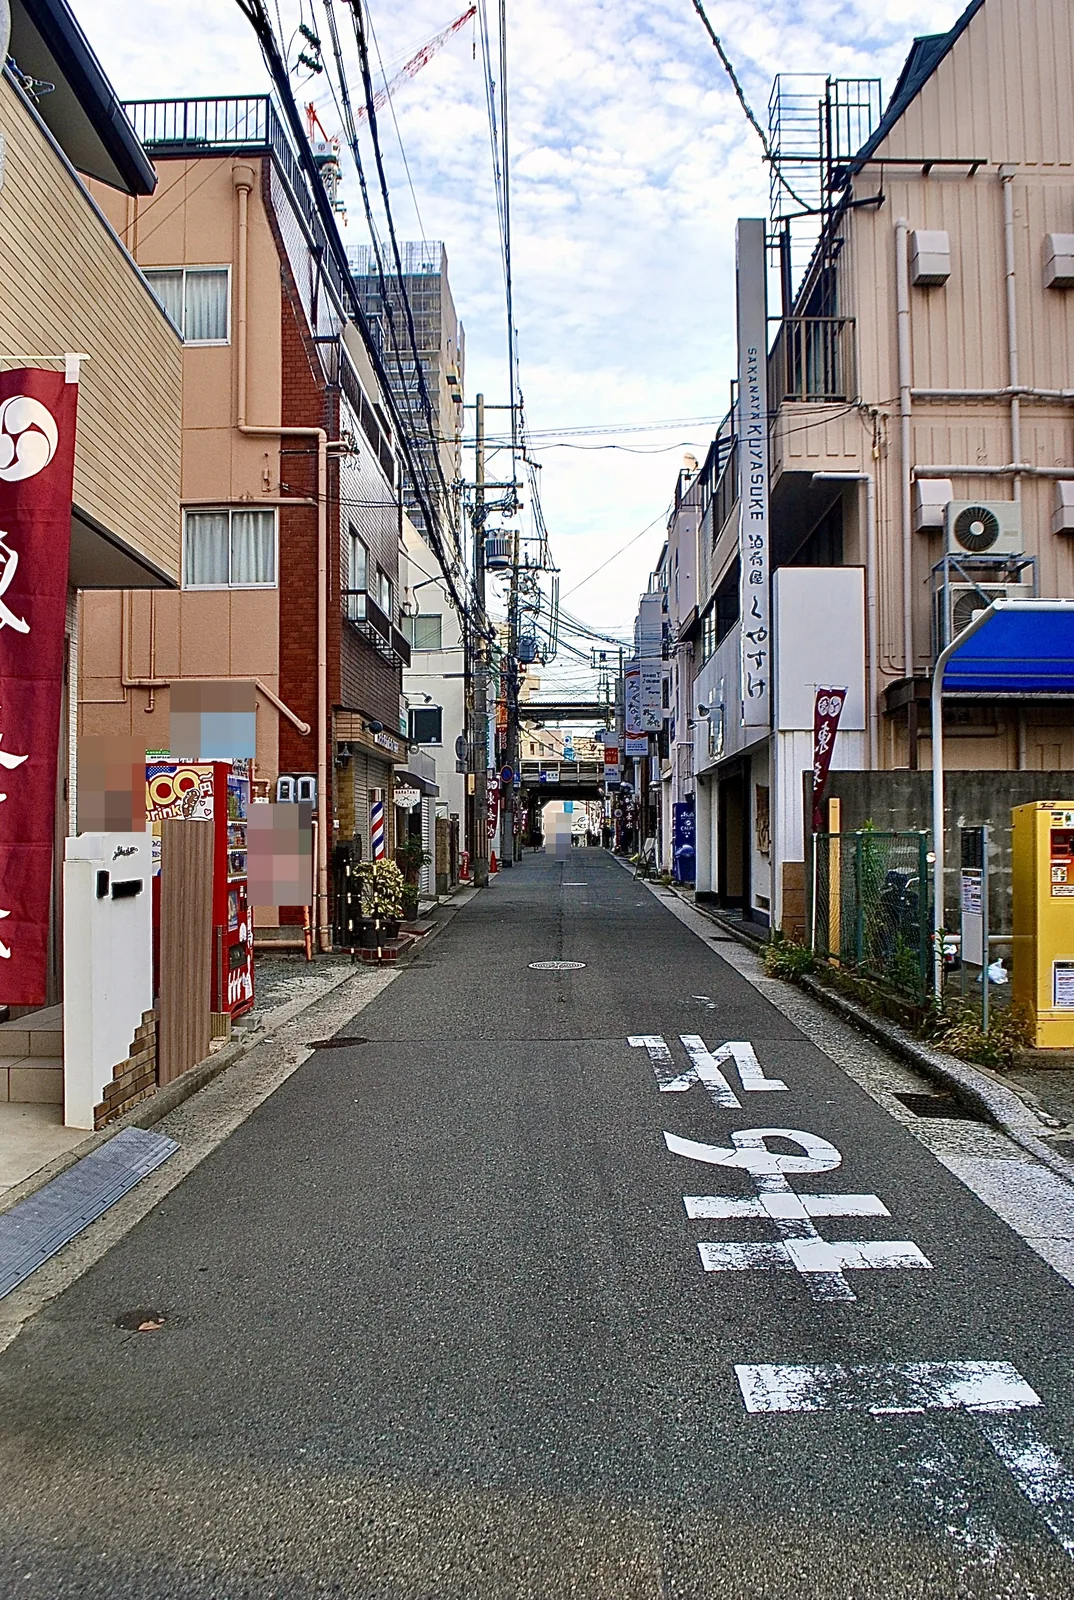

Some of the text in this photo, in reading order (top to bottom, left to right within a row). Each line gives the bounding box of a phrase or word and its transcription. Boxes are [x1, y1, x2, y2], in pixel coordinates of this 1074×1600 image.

[747, 347, 764, 520] SAKANAYA KUYASUKE
[746, 595, 768, 698] くやすけ
